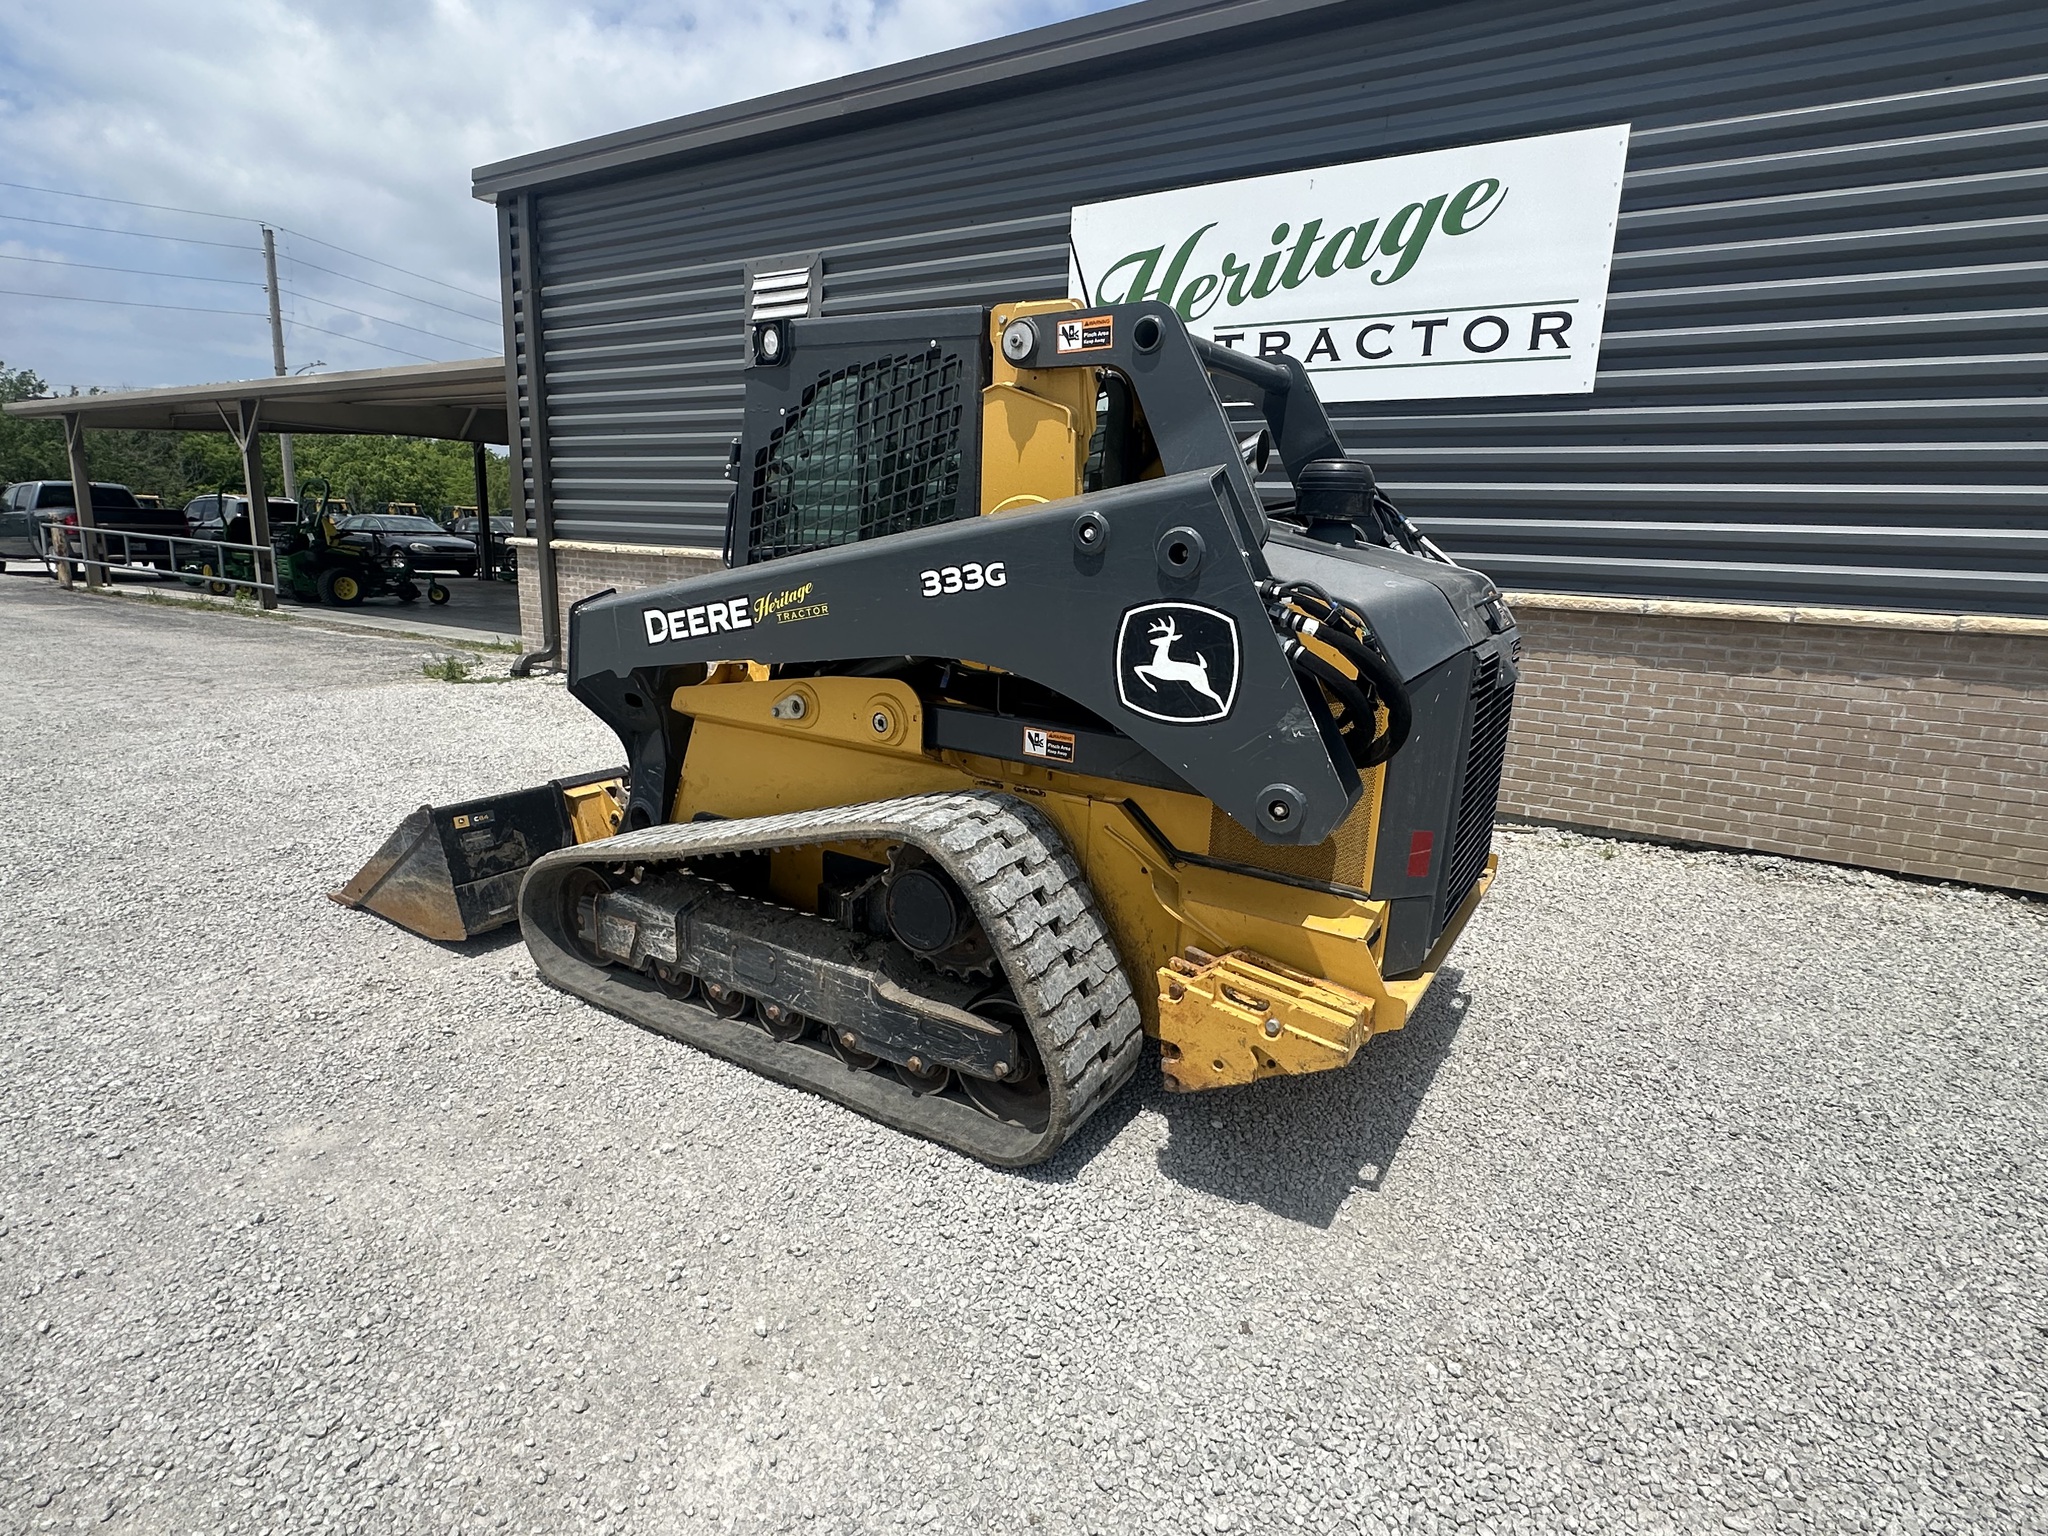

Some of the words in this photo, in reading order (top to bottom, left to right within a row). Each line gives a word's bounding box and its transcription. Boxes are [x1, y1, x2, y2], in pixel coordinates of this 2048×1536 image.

[1096, 177, 1508, 323] Heritage
[1213, 311, 1573, 364] TRACTOR
[920, 562, 1007, 597] 333G
[643, 597, 753, 644] DEERE
[753, 581, 814, 624] Heritage
[776, 605, 830, 622] TRACTOR
